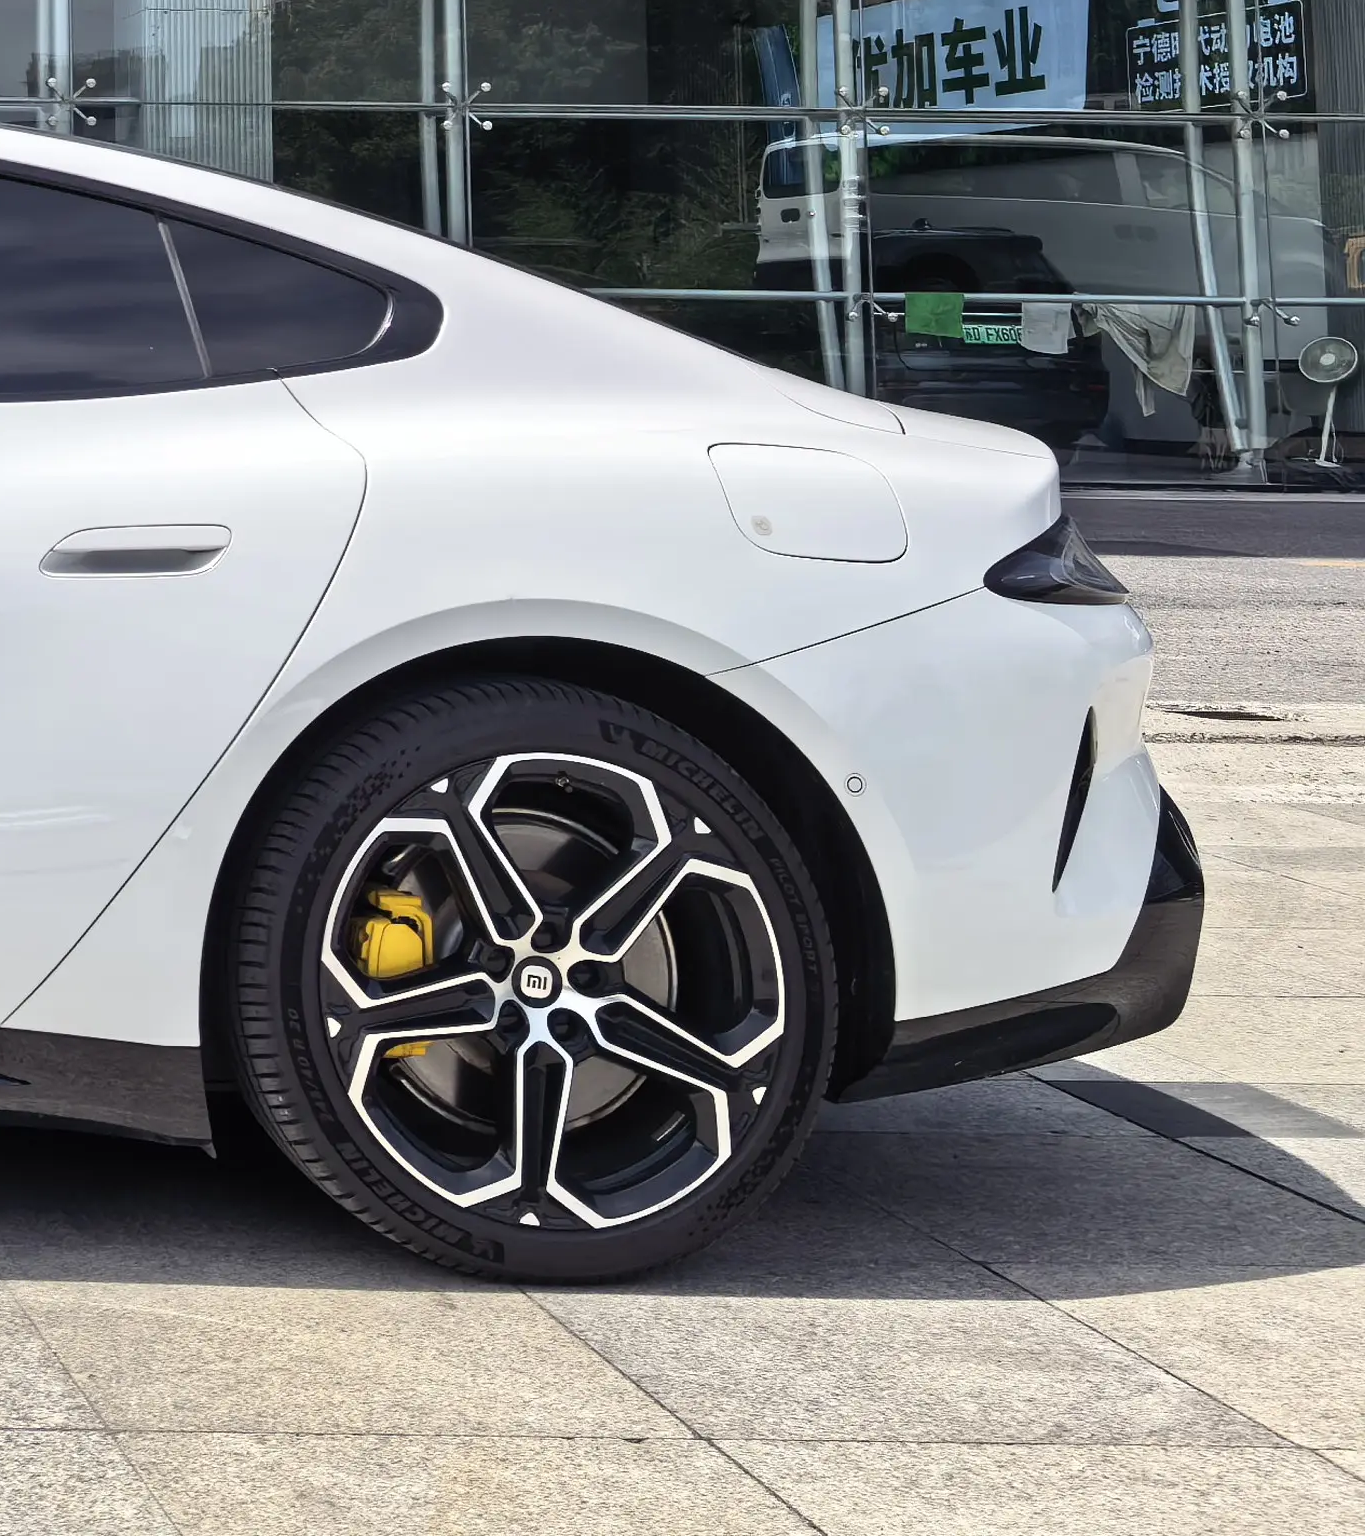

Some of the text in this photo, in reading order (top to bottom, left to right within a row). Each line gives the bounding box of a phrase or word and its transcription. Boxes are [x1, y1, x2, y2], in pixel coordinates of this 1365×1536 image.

[852, 6, 1046, 109] 优加车业
[1133, 12, 1296, 66] 宁德代动电池
[640, 739, 766, 841] MICHELIN
[335, 1141, 466, 1246] MICHELIN
